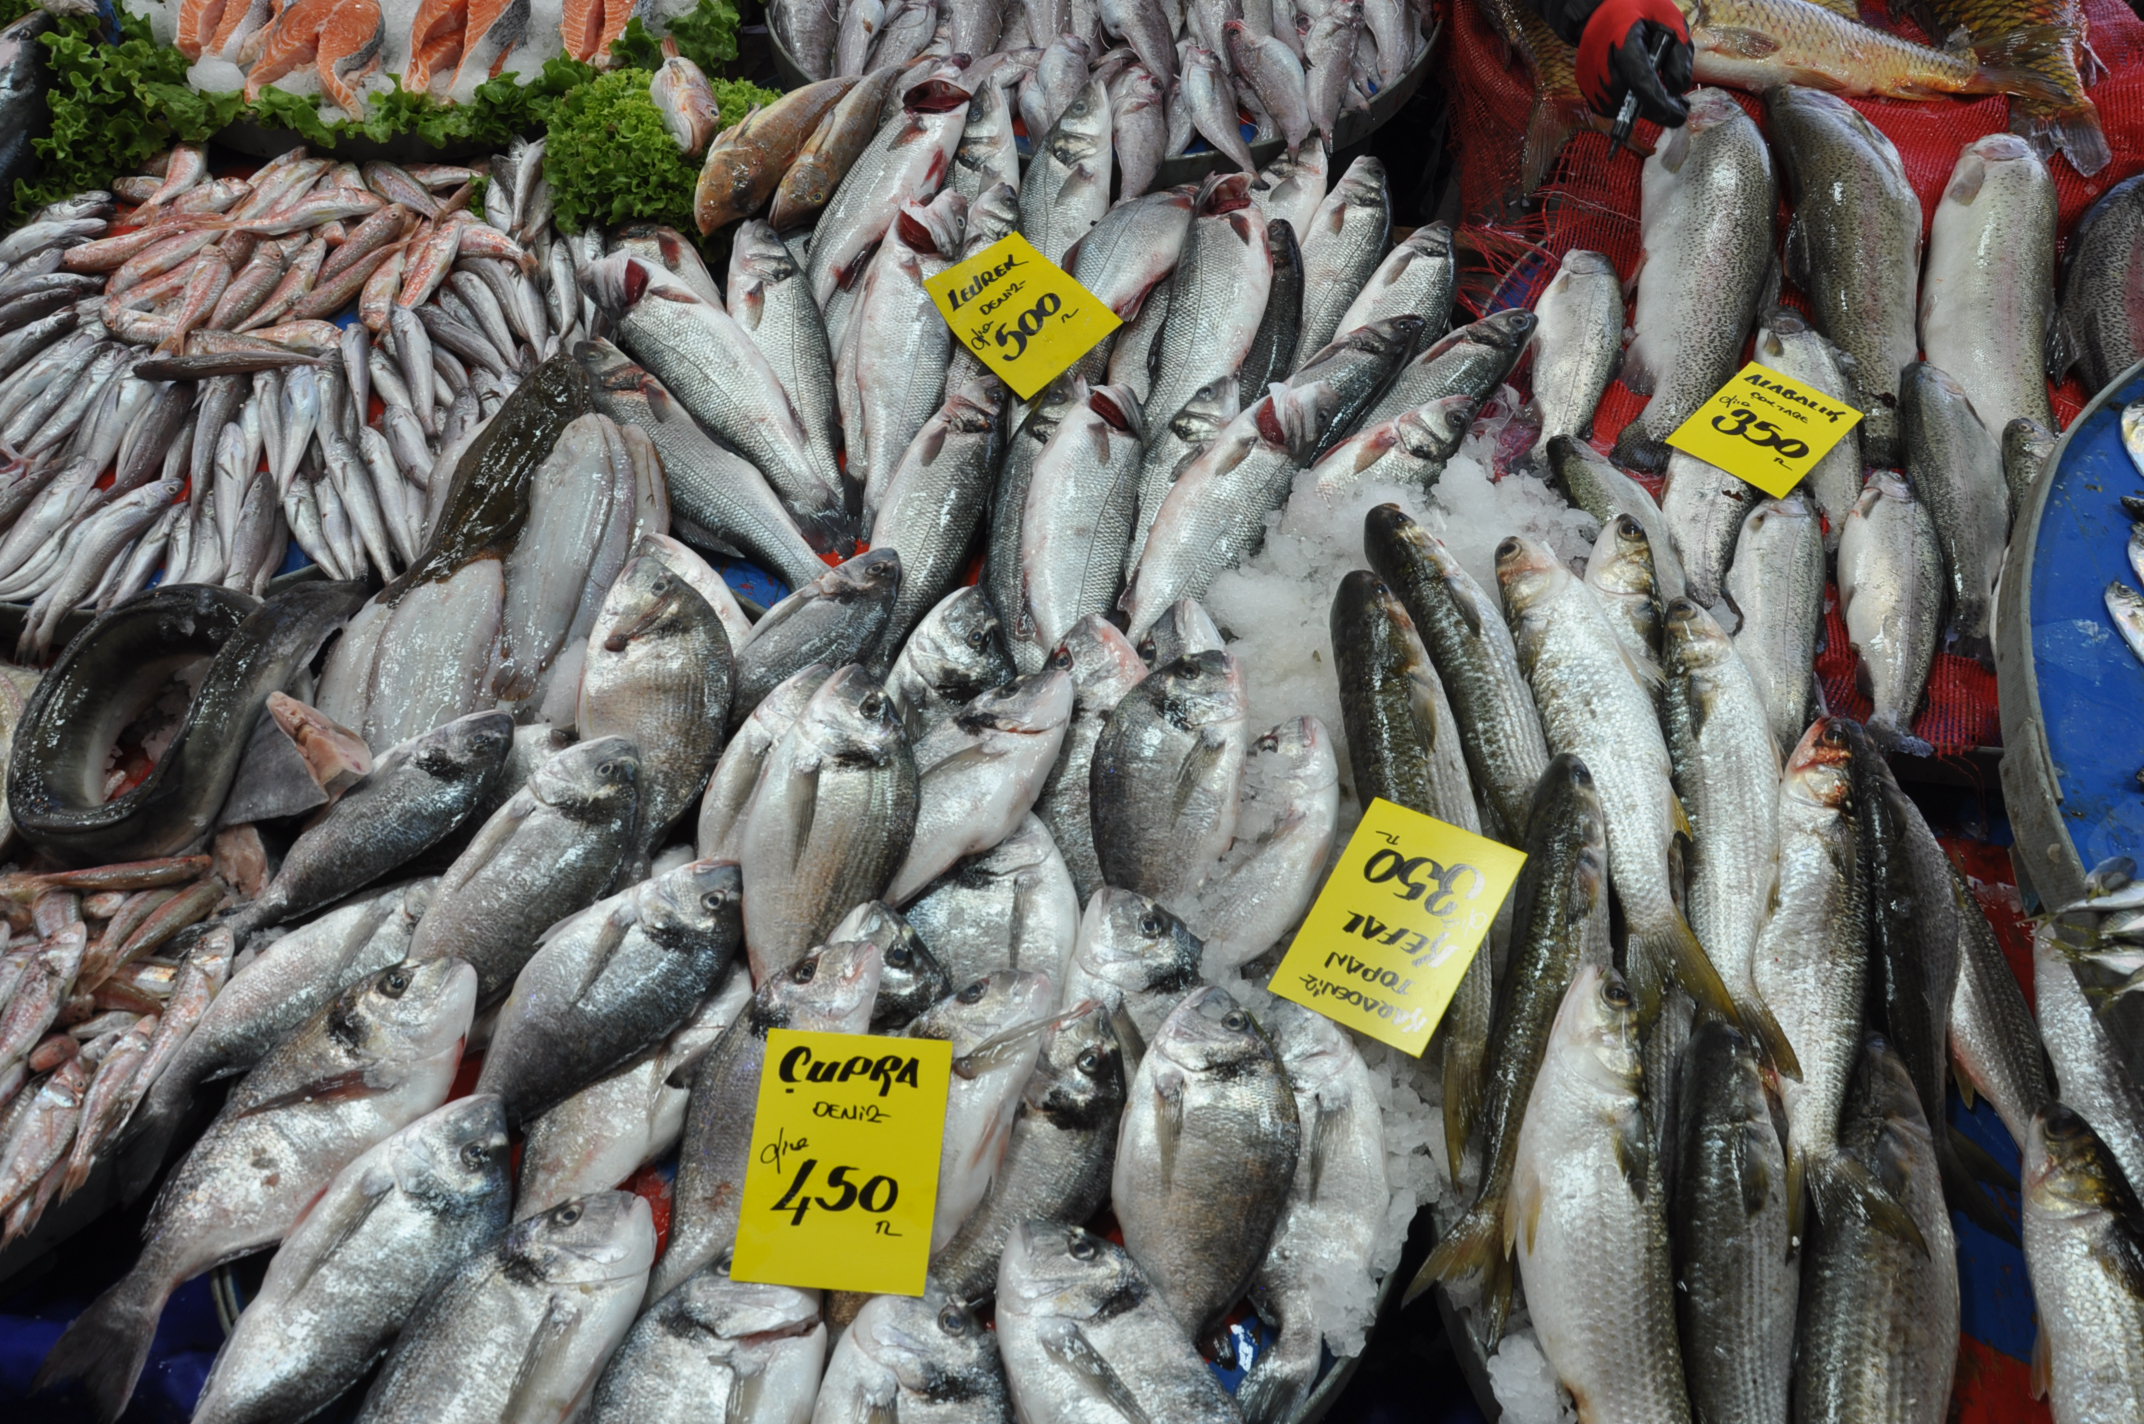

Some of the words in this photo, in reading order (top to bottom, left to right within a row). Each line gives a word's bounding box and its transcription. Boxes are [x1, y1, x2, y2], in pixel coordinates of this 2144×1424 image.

[995, 293, 1061, 362] 500
[1744, 374, 1846, 423] ALABALIK
[1711, 409, 1809, 458] 350
[1364, 848, 1486, 917] 350
[1341, 910, 1458, 969] KEFAL
[1324, 951, 1416, 996] TOPAN
[779, 1045, 919, 1097] ÇUPRA
[769, 1158, 898, 1226] 450
